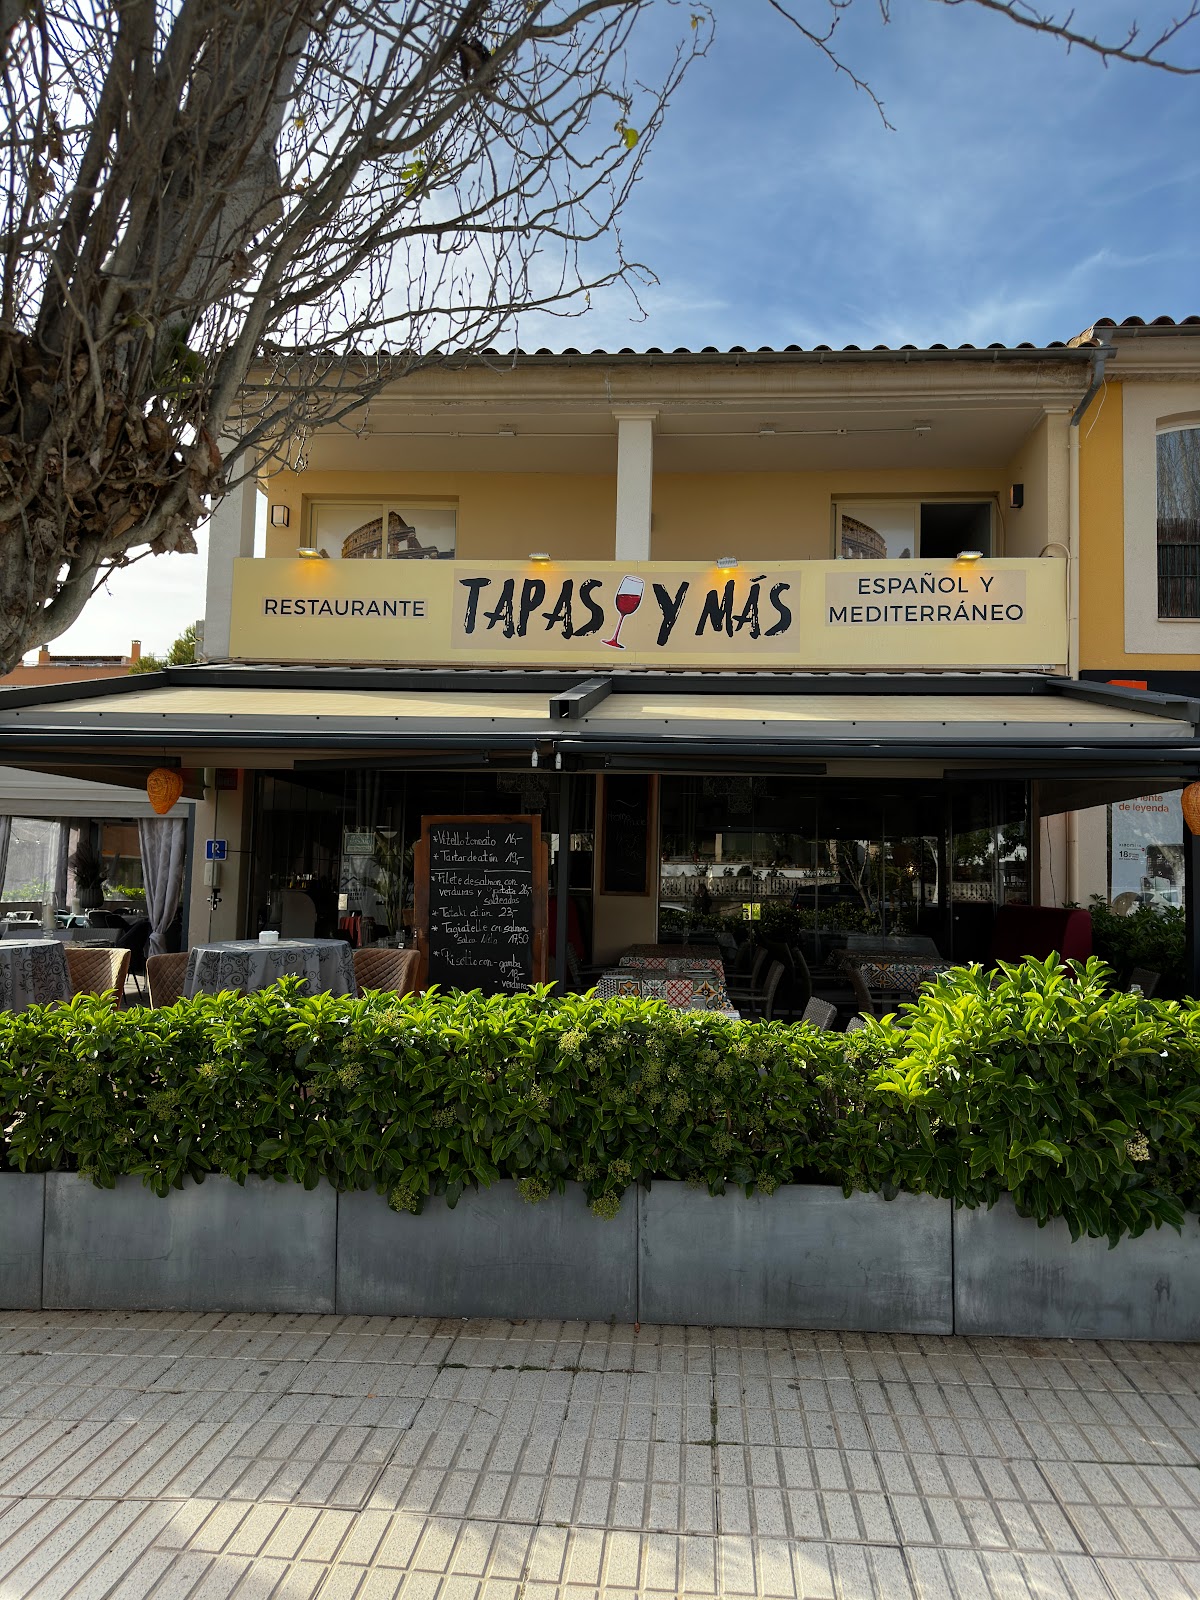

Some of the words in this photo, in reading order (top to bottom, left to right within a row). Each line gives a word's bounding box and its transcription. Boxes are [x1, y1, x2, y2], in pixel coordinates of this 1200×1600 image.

[858, 572, 969, 595] ESPAÑOL
[979, 576, 995, 593] Y
[264, 598, 425, 617] RESTAURANTE
[459, 577, 604, 640] TAPAS
[652, 581, 690, 647] Y
[694, 574, 792, 640] MÁS
[829, 600, 1024, 623] MEDITERRÁNEO
[1118, 803, 1130, 811] de
[1132, 803, 1169, 813] leyenda
[467, 850, 477, 862] de
[463, 873, 474, 886] de
